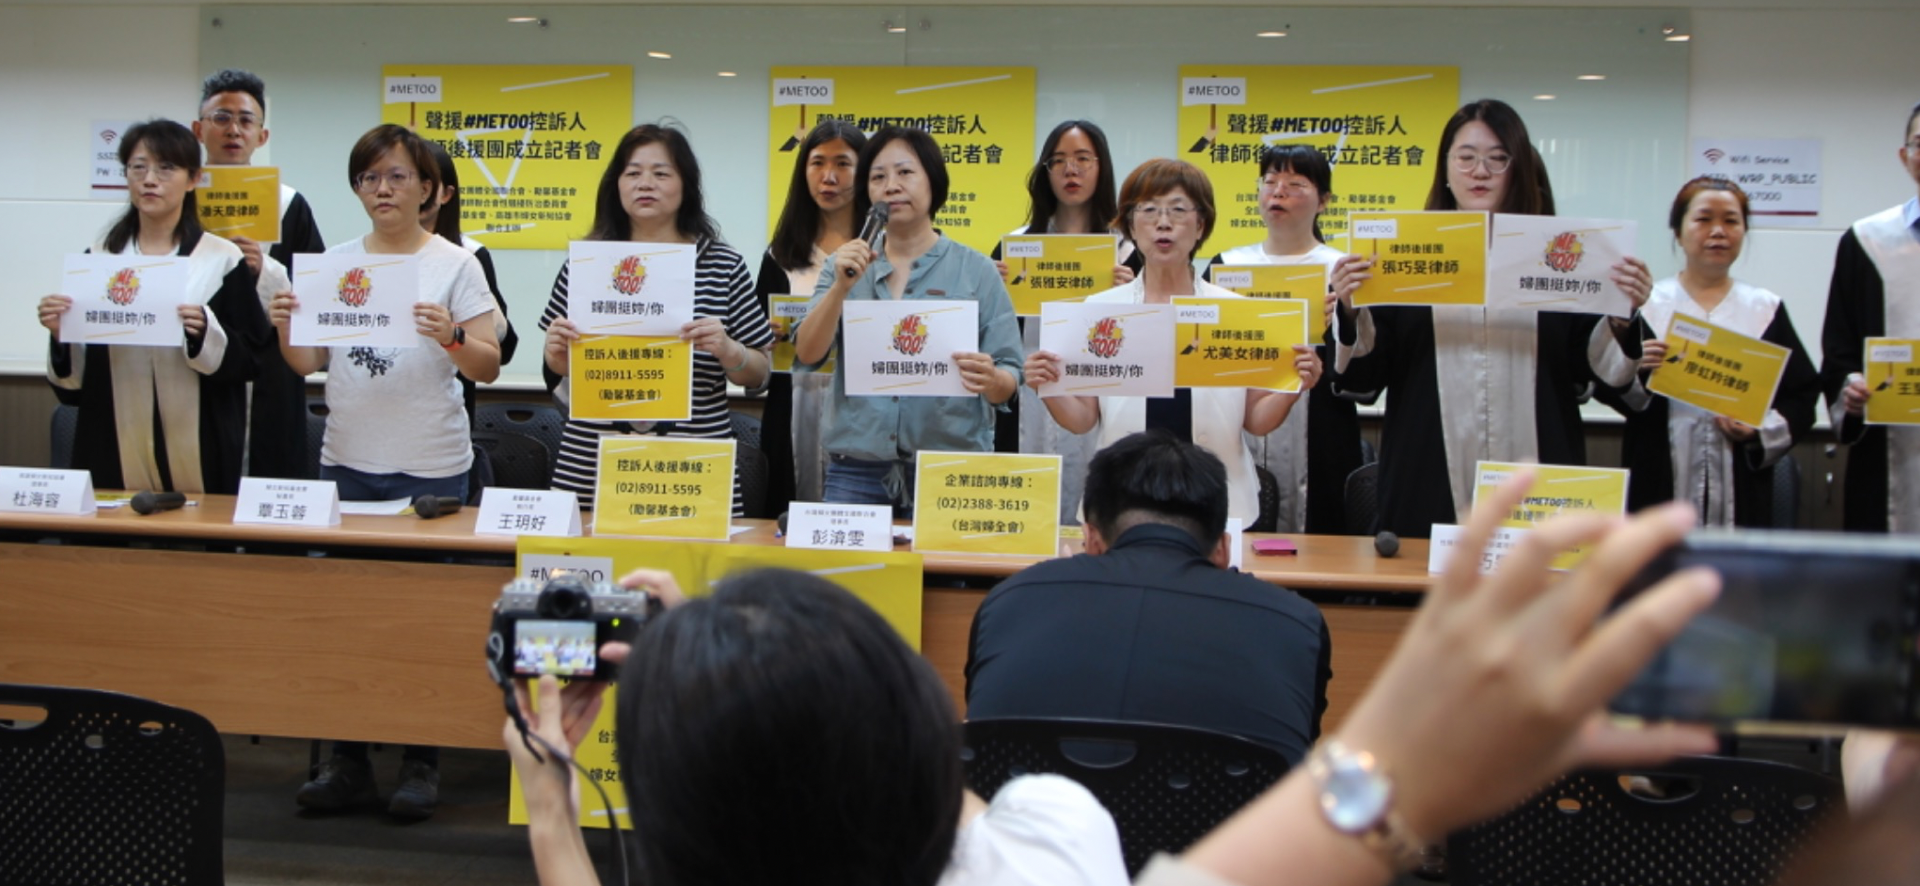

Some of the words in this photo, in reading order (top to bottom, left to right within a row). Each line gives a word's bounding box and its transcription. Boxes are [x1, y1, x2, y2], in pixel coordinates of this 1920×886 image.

[390, 83, 437, 95] #METOO
[779, 85, 828, 97] #METOO
[1188, 84, 1240, 96] #METOO
[425, 110, 587, 132] 聲援#METOO控訴人
[1227, 113, 1408, 136] 聲援#METOO控訴人
[1209, 144, 1425, 166] 律師後成立記者會
[1755, 155, 1790, 164] Service
[1389, 244, 1445, 255] 律師後援團
[1036, 261, 1081, 272] 律師後援團
[1381, 260, 1460, 275] 張巧旻律師
[1030, 276, 1095, 289] 張雅安律師
[1519, 277, 1602, 293] 婦團挺妳/你
[591, 300, 665, 315] 婦團挺妳/你
[1179, 310, 1216, 319] #METOO
[84, 310, 156, 327] 婦團挺妳/你
[317, 310, 391, 327] 婦團挺妳/你
[1210, 329, 1265, 341] 律師後援團
[584, 348, 672, 361] 控訴人後援專線：
[1202, 347, 1280, 361] 尤美女律師
[871, 360, 948, 376] 婦團挺妳/你
[1065, 363, 1143, 379] 婦團挺妳/你
[584, 369, 665, 382] (02)8911-5595
[616, 458, 712, 474] 控訴人後援專線：
[944, 473, 1033, 489] 企業諮詢專線：
[615, 482, 702, 496] (02)8911-5595
[13, 491, 61, 508] 杜海容
[936, 497, 1030, 511] (02)2388-3619
[498, 513, 547, 531] 王玥好
